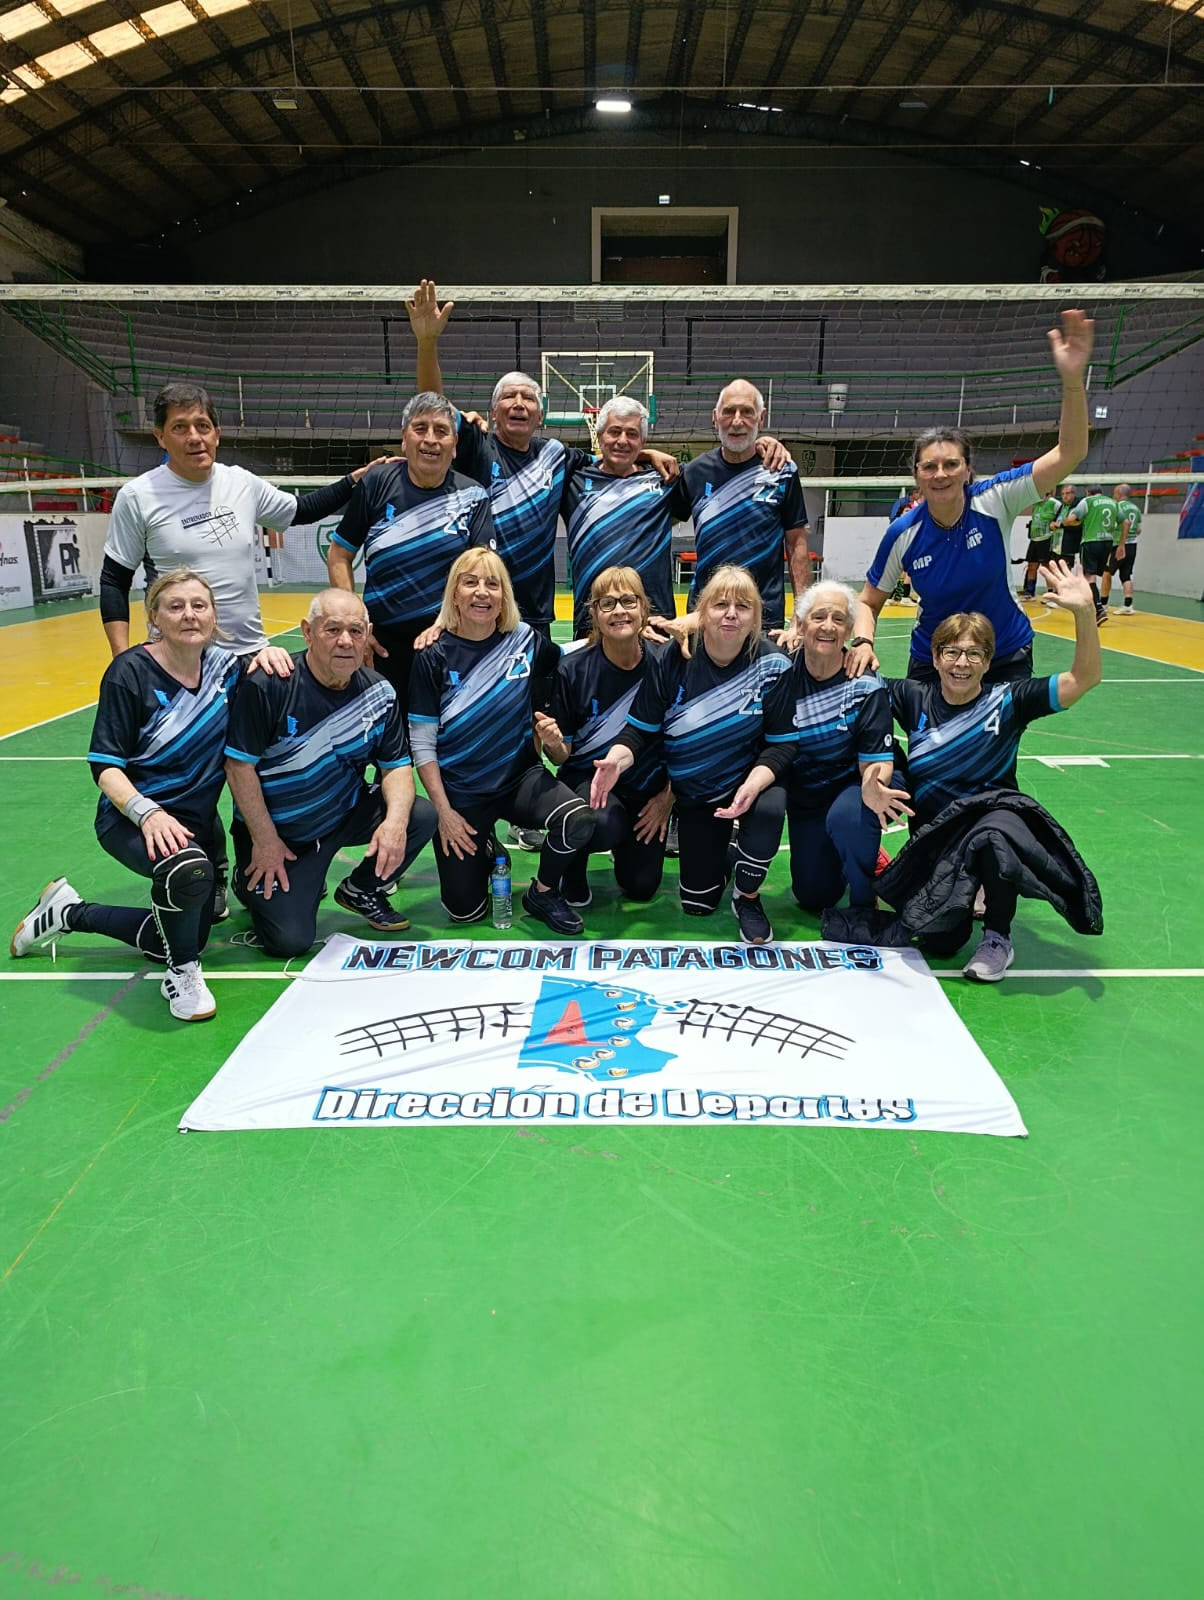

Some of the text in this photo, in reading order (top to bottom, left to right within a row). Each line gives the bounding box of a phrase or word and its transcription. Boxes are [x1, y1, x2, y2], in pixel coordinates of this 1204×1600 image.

[753, 480, 779, 503] 22
[1102, 508, 1112, 528] 3
[1128, 512, 1136, 529] 9
[966, 532, 983, 550] MP
[912, 554, 933, 570] MP
[506, 652, 531, 680] 23
[361, 716, 374, 743] 7
[984, 708, 1001, 736] 4
[342, 944, 884, 970] NEWCOM PATAGONES
[312, 1085, 917, 1121] Dirección de Deportes
